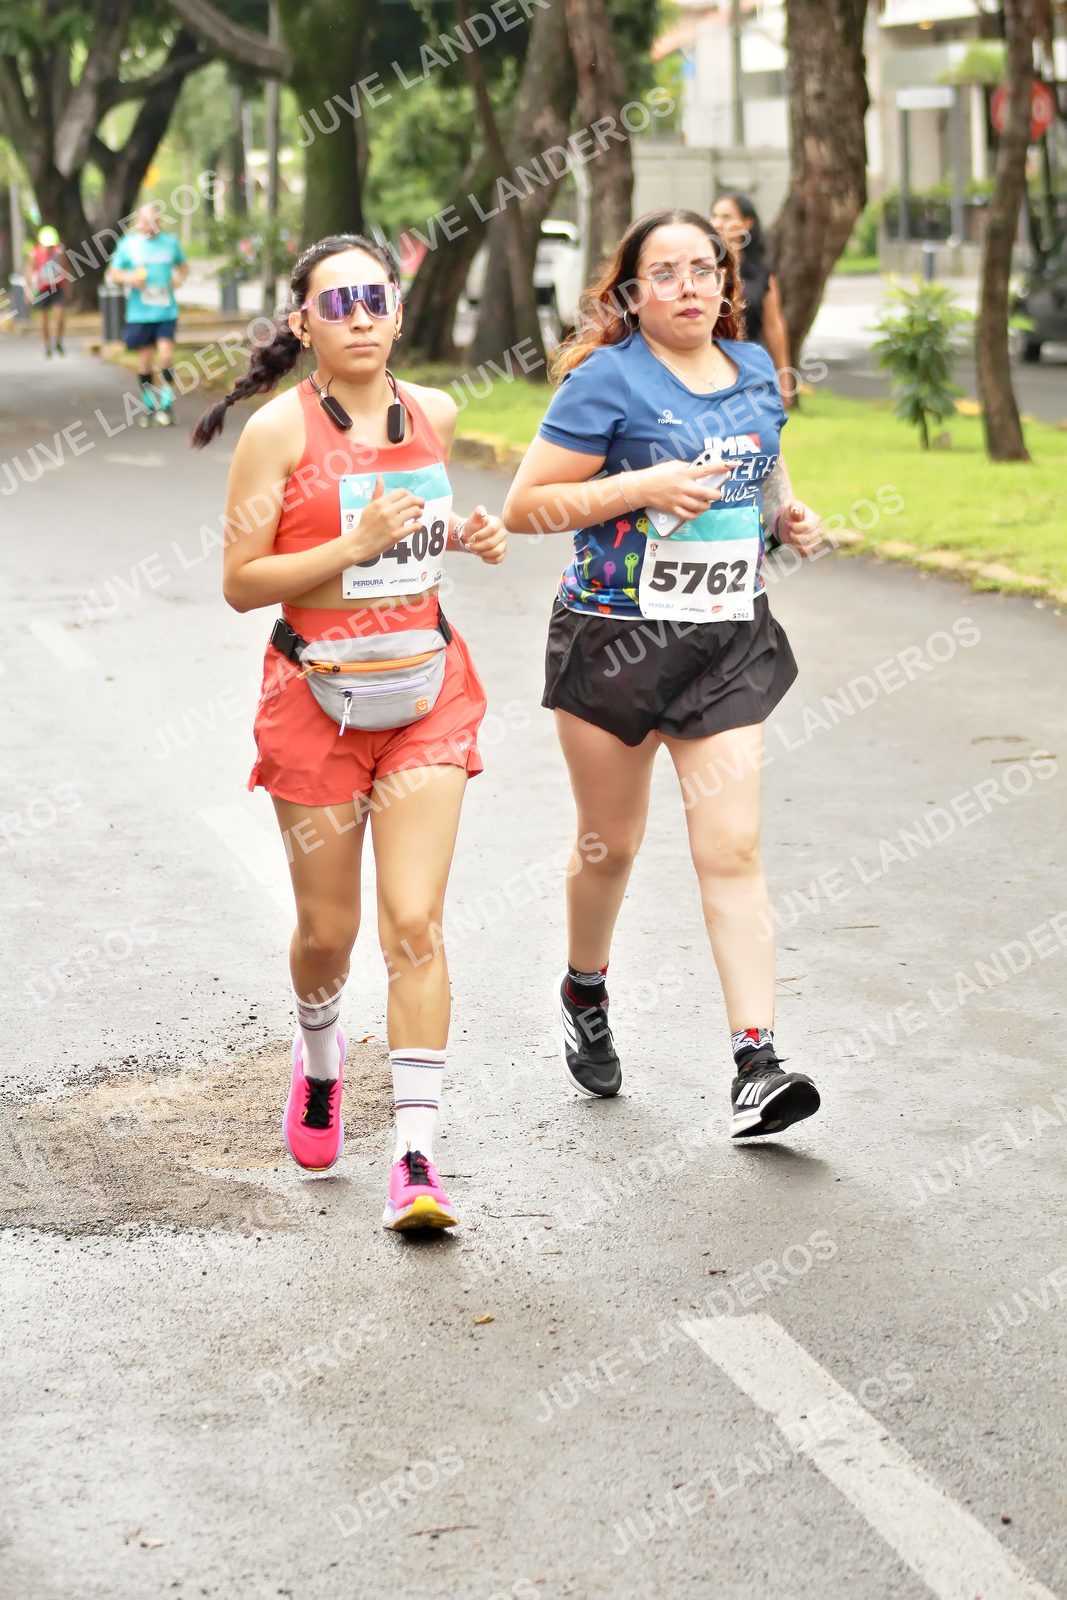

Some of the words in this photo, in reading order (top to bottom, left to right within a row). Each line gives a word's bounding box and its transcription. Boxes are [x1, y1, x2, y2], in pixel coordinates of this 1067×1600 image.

[354, 520, 445, 568] 408
[353, 579, 384, 588] PERDURA
[648, 560, 749, 596] 5762
